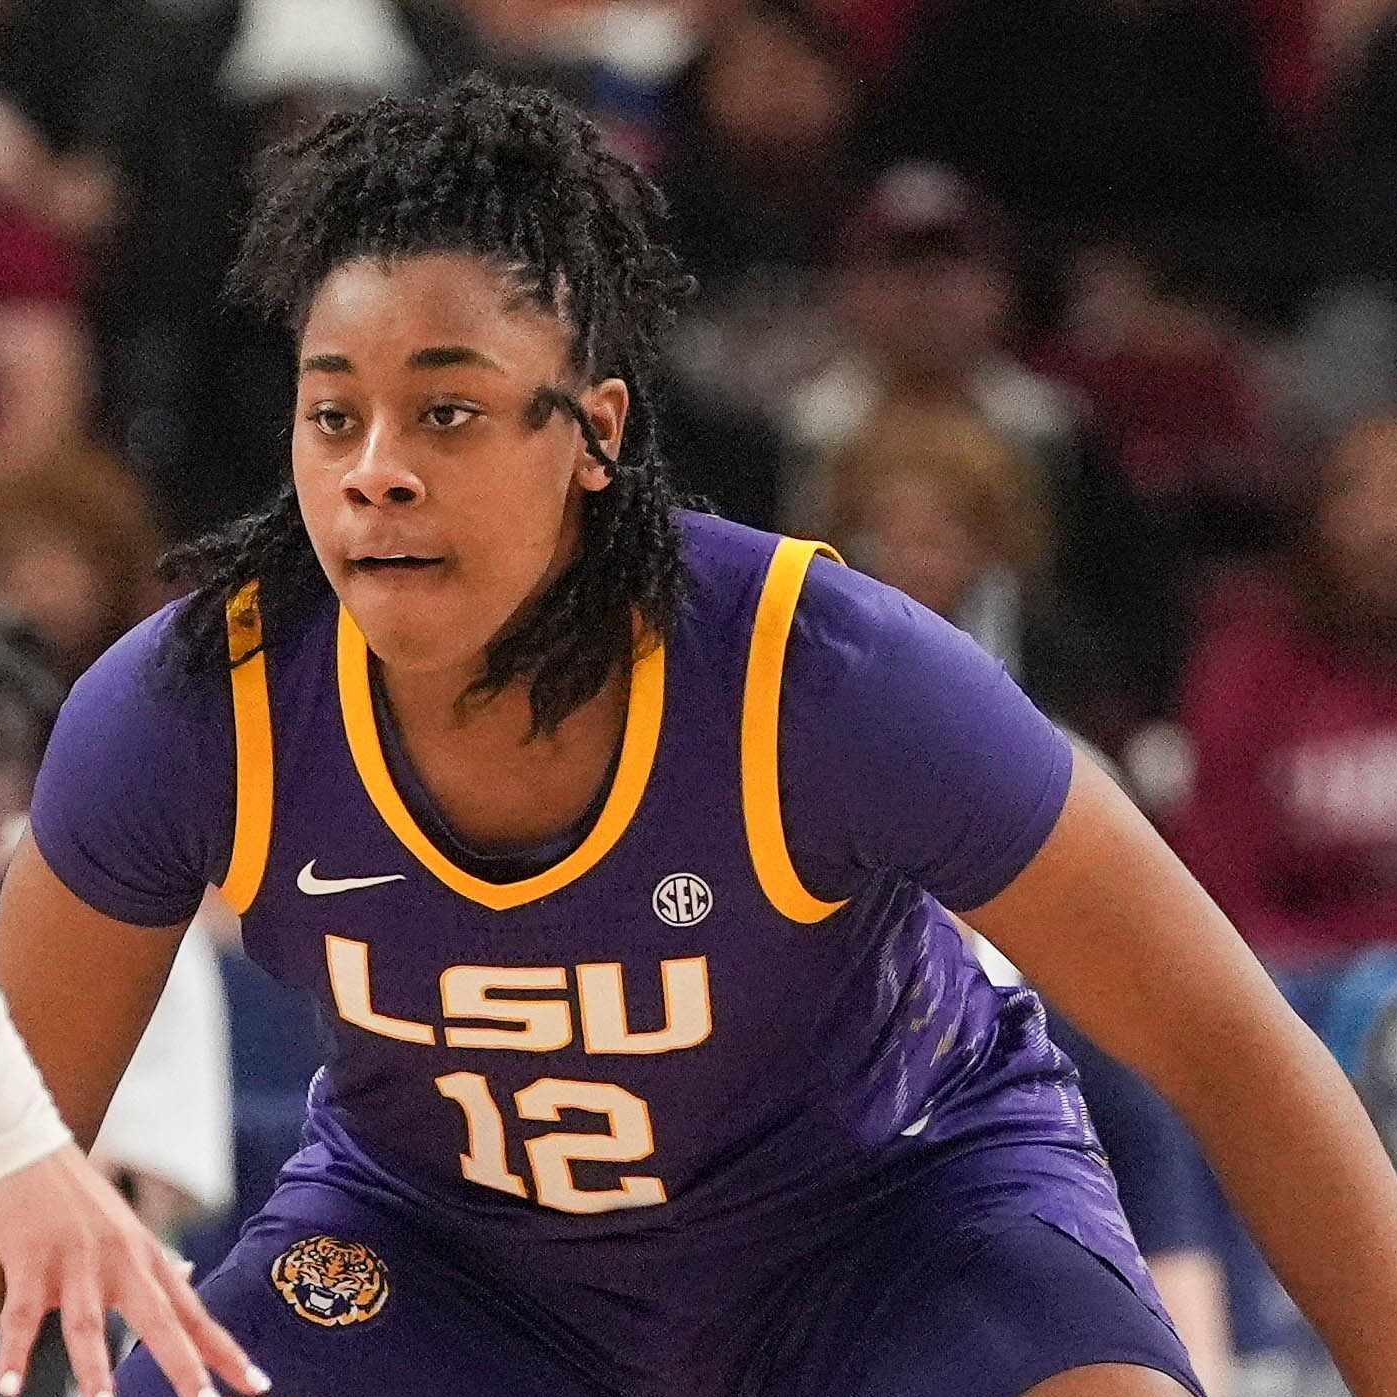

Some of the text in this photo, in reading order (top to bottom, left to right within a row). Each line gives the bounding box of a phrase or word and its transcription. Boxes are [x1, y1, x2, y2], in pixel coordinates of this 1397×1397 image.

[657, 875, 709, 924] SEC
[324, 934, 713, 1055] LSU
[434, 1071, 668, 1215] 12
